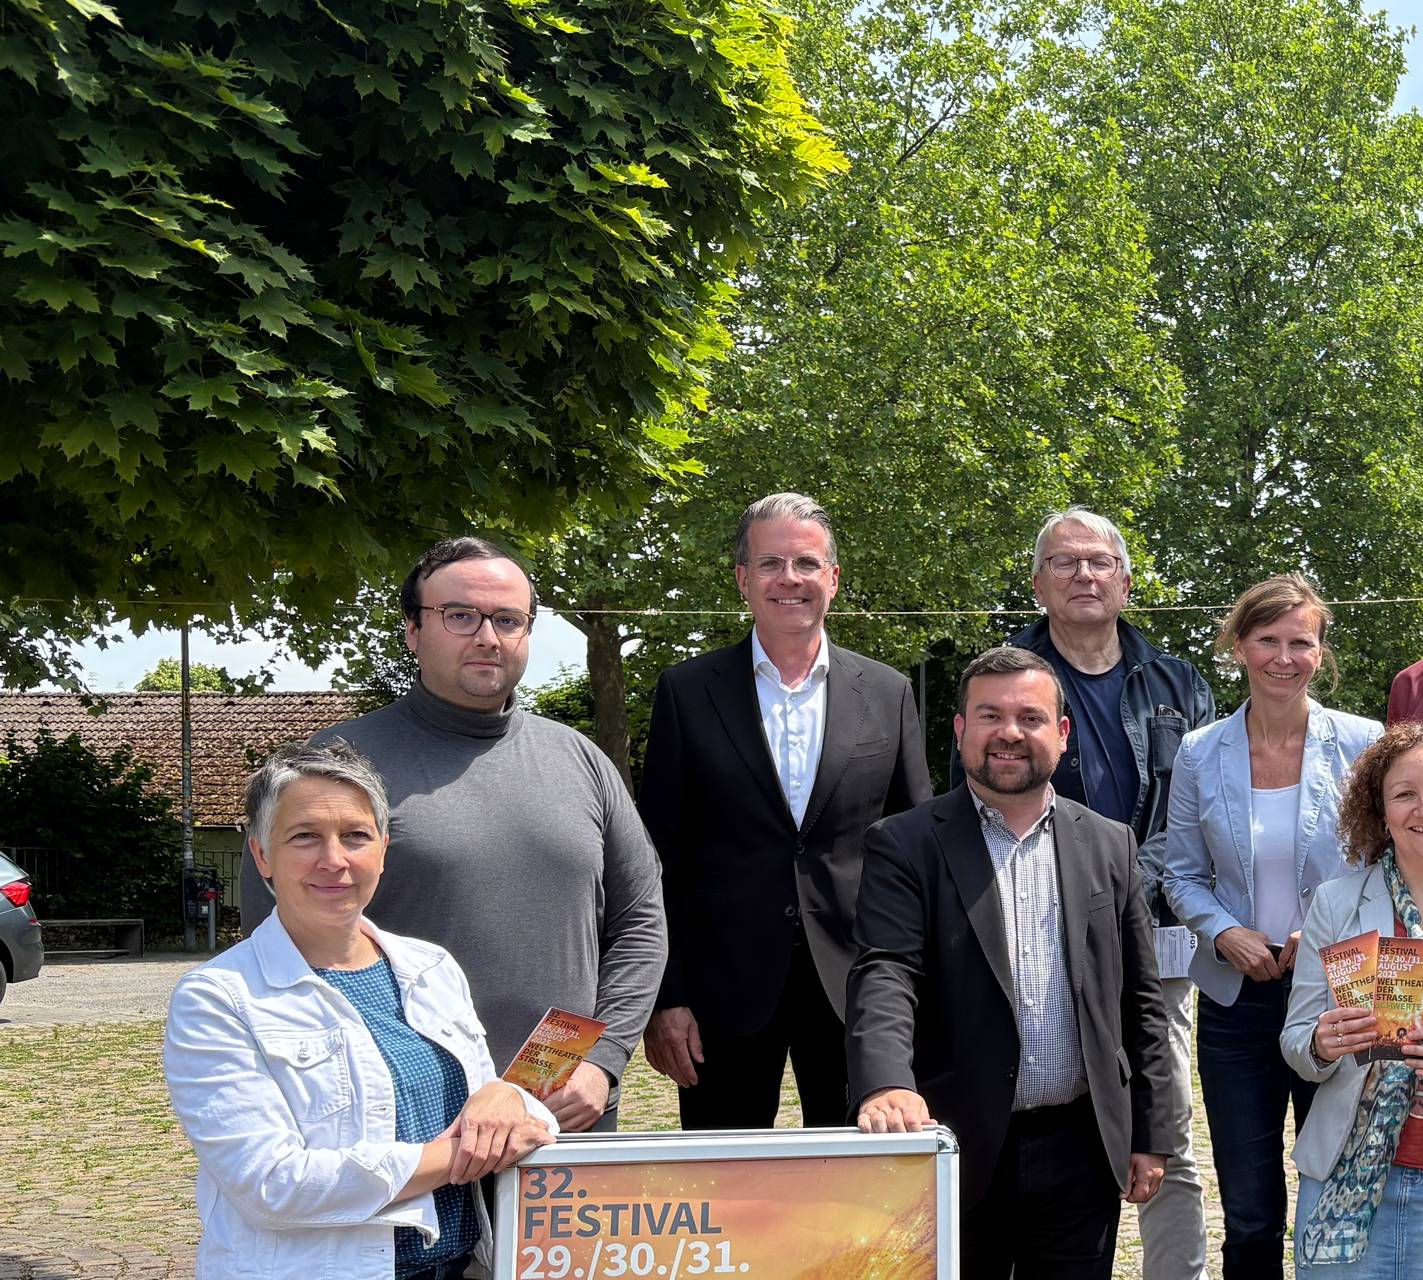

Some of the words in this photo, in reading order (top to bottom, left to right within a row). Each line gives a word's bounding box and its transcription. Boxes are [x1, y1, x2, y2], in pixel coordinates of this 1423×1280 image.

[1324, 947, 1361, 964] FESTIVAL
[1380, 947, 1418, 956] FESTIVAL
[1327, 953, 1369, 973] 29./30./31.
[1379, 954, 1423, 965] 29./30./31.
[1329, 963, 1361, 979] AUGUST
[1378, 963, 1413, 971] AUGUST
[1378, 970, 1397, 978] 2025
[1331, 975, 1351, 988] 2025
[1333, 975, 1376, 994] WELTTHEA
[1336, 991, 1353, 1002] DER
[1376, 994, 1413, 1002] STRASSE
[545, 1017, 580, 1031] FESTIVAL
[535, 1029, 569, 1043] AUGUST
[523, 1048, 540, 1058] DER
[528, 1042, 583, 1061] WELTTHEATER
[518, 1054, 554, 1069] STRASSE
[524, 1167, 587, 1200] 32.
[524, 1202, 722, 1240] FESTIVAL
[520, 1238, 750, 1280] 29./30./31.
